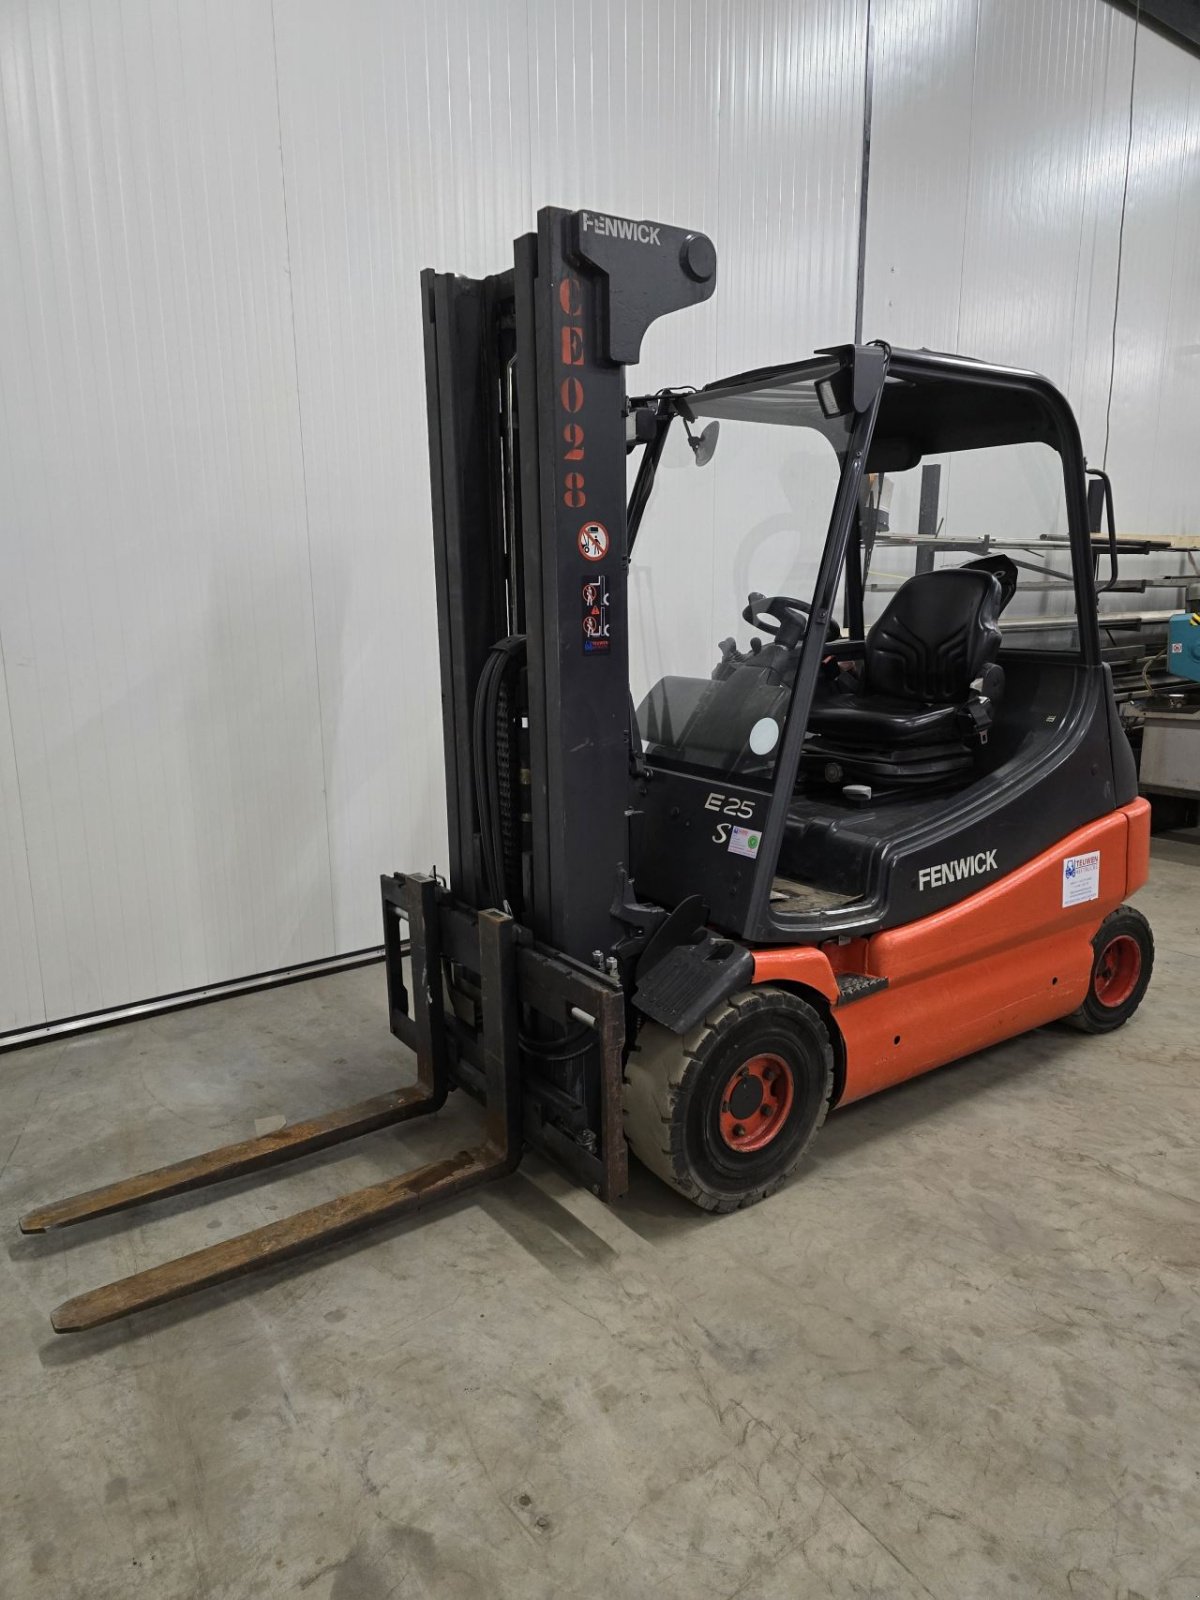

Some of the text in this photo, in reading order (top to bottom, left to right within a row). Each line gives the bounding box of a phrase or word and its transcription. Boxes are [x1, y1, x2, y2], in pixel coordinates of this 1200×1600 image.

[582, 212, 660, 246] FENWICK
[712, 823, 732, 844] S
[919, 849, 998, 891] FENWICK
